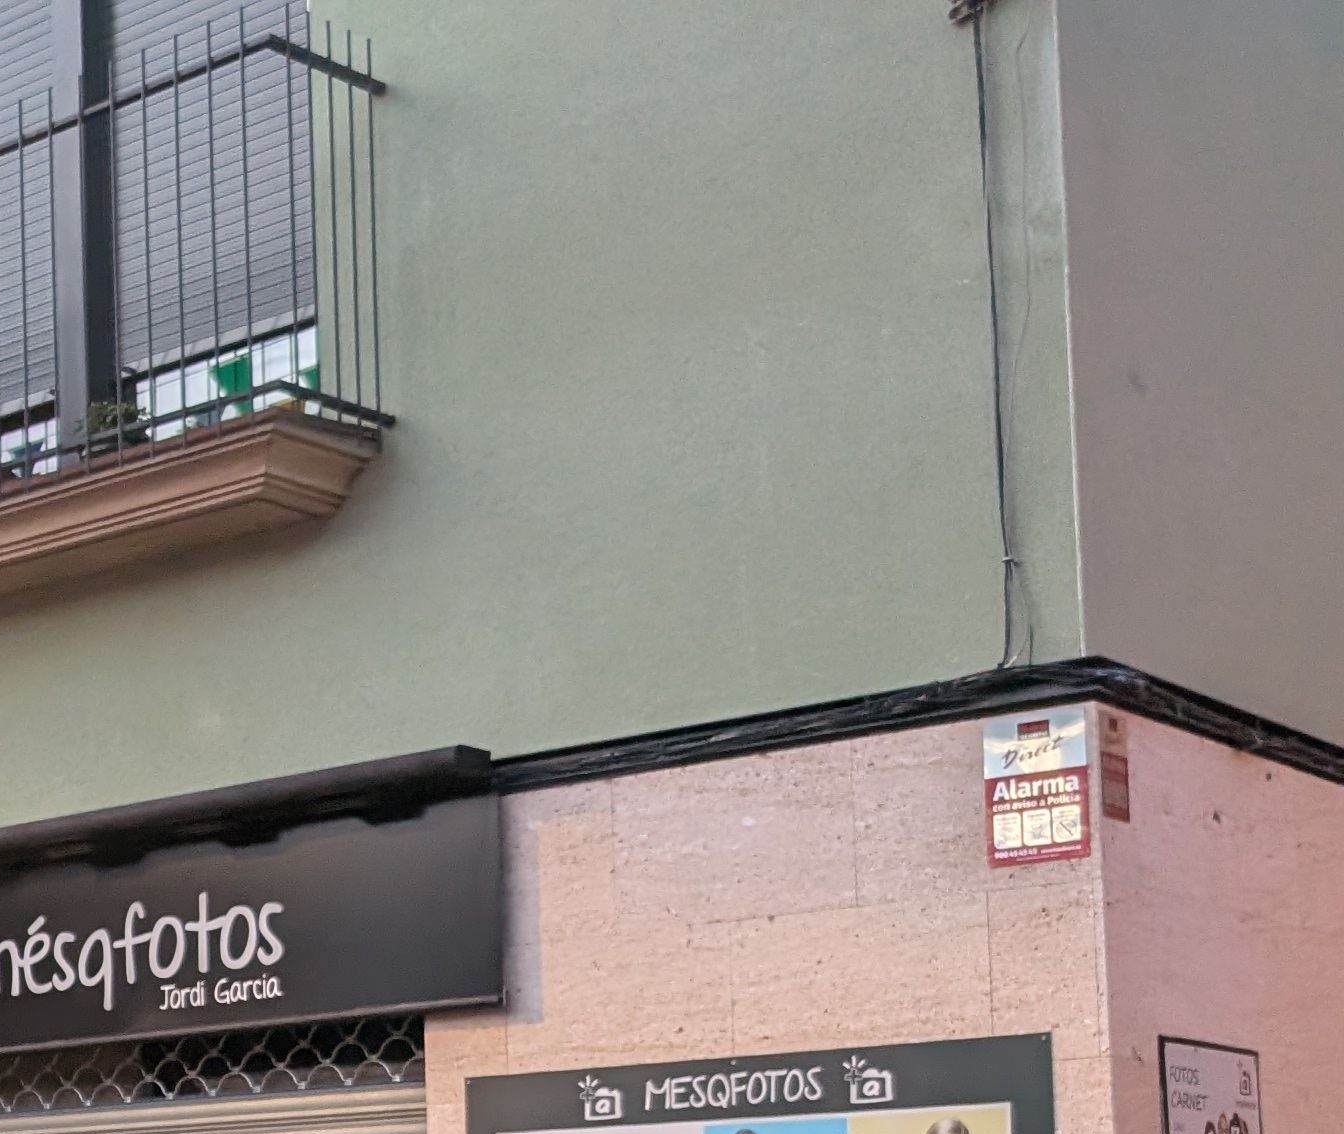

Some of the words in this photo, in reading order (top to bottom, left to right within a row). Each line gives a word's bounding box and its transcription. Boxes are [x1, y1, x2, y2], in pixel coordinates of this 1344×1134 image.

[1001, 735, 1063, 770] Direct
[993, 775, 1079, 801] Alarma
[993, 803, 1010, 812] con
[1012, 799, 1037, 810] aviso
[1039, 799, 1045, 807] a
[159, 981, 206, 1010] Jordi
[214, 973, 283, 1004] Garcia
[644, 1066, 823, 1111] MESQFOTOS
